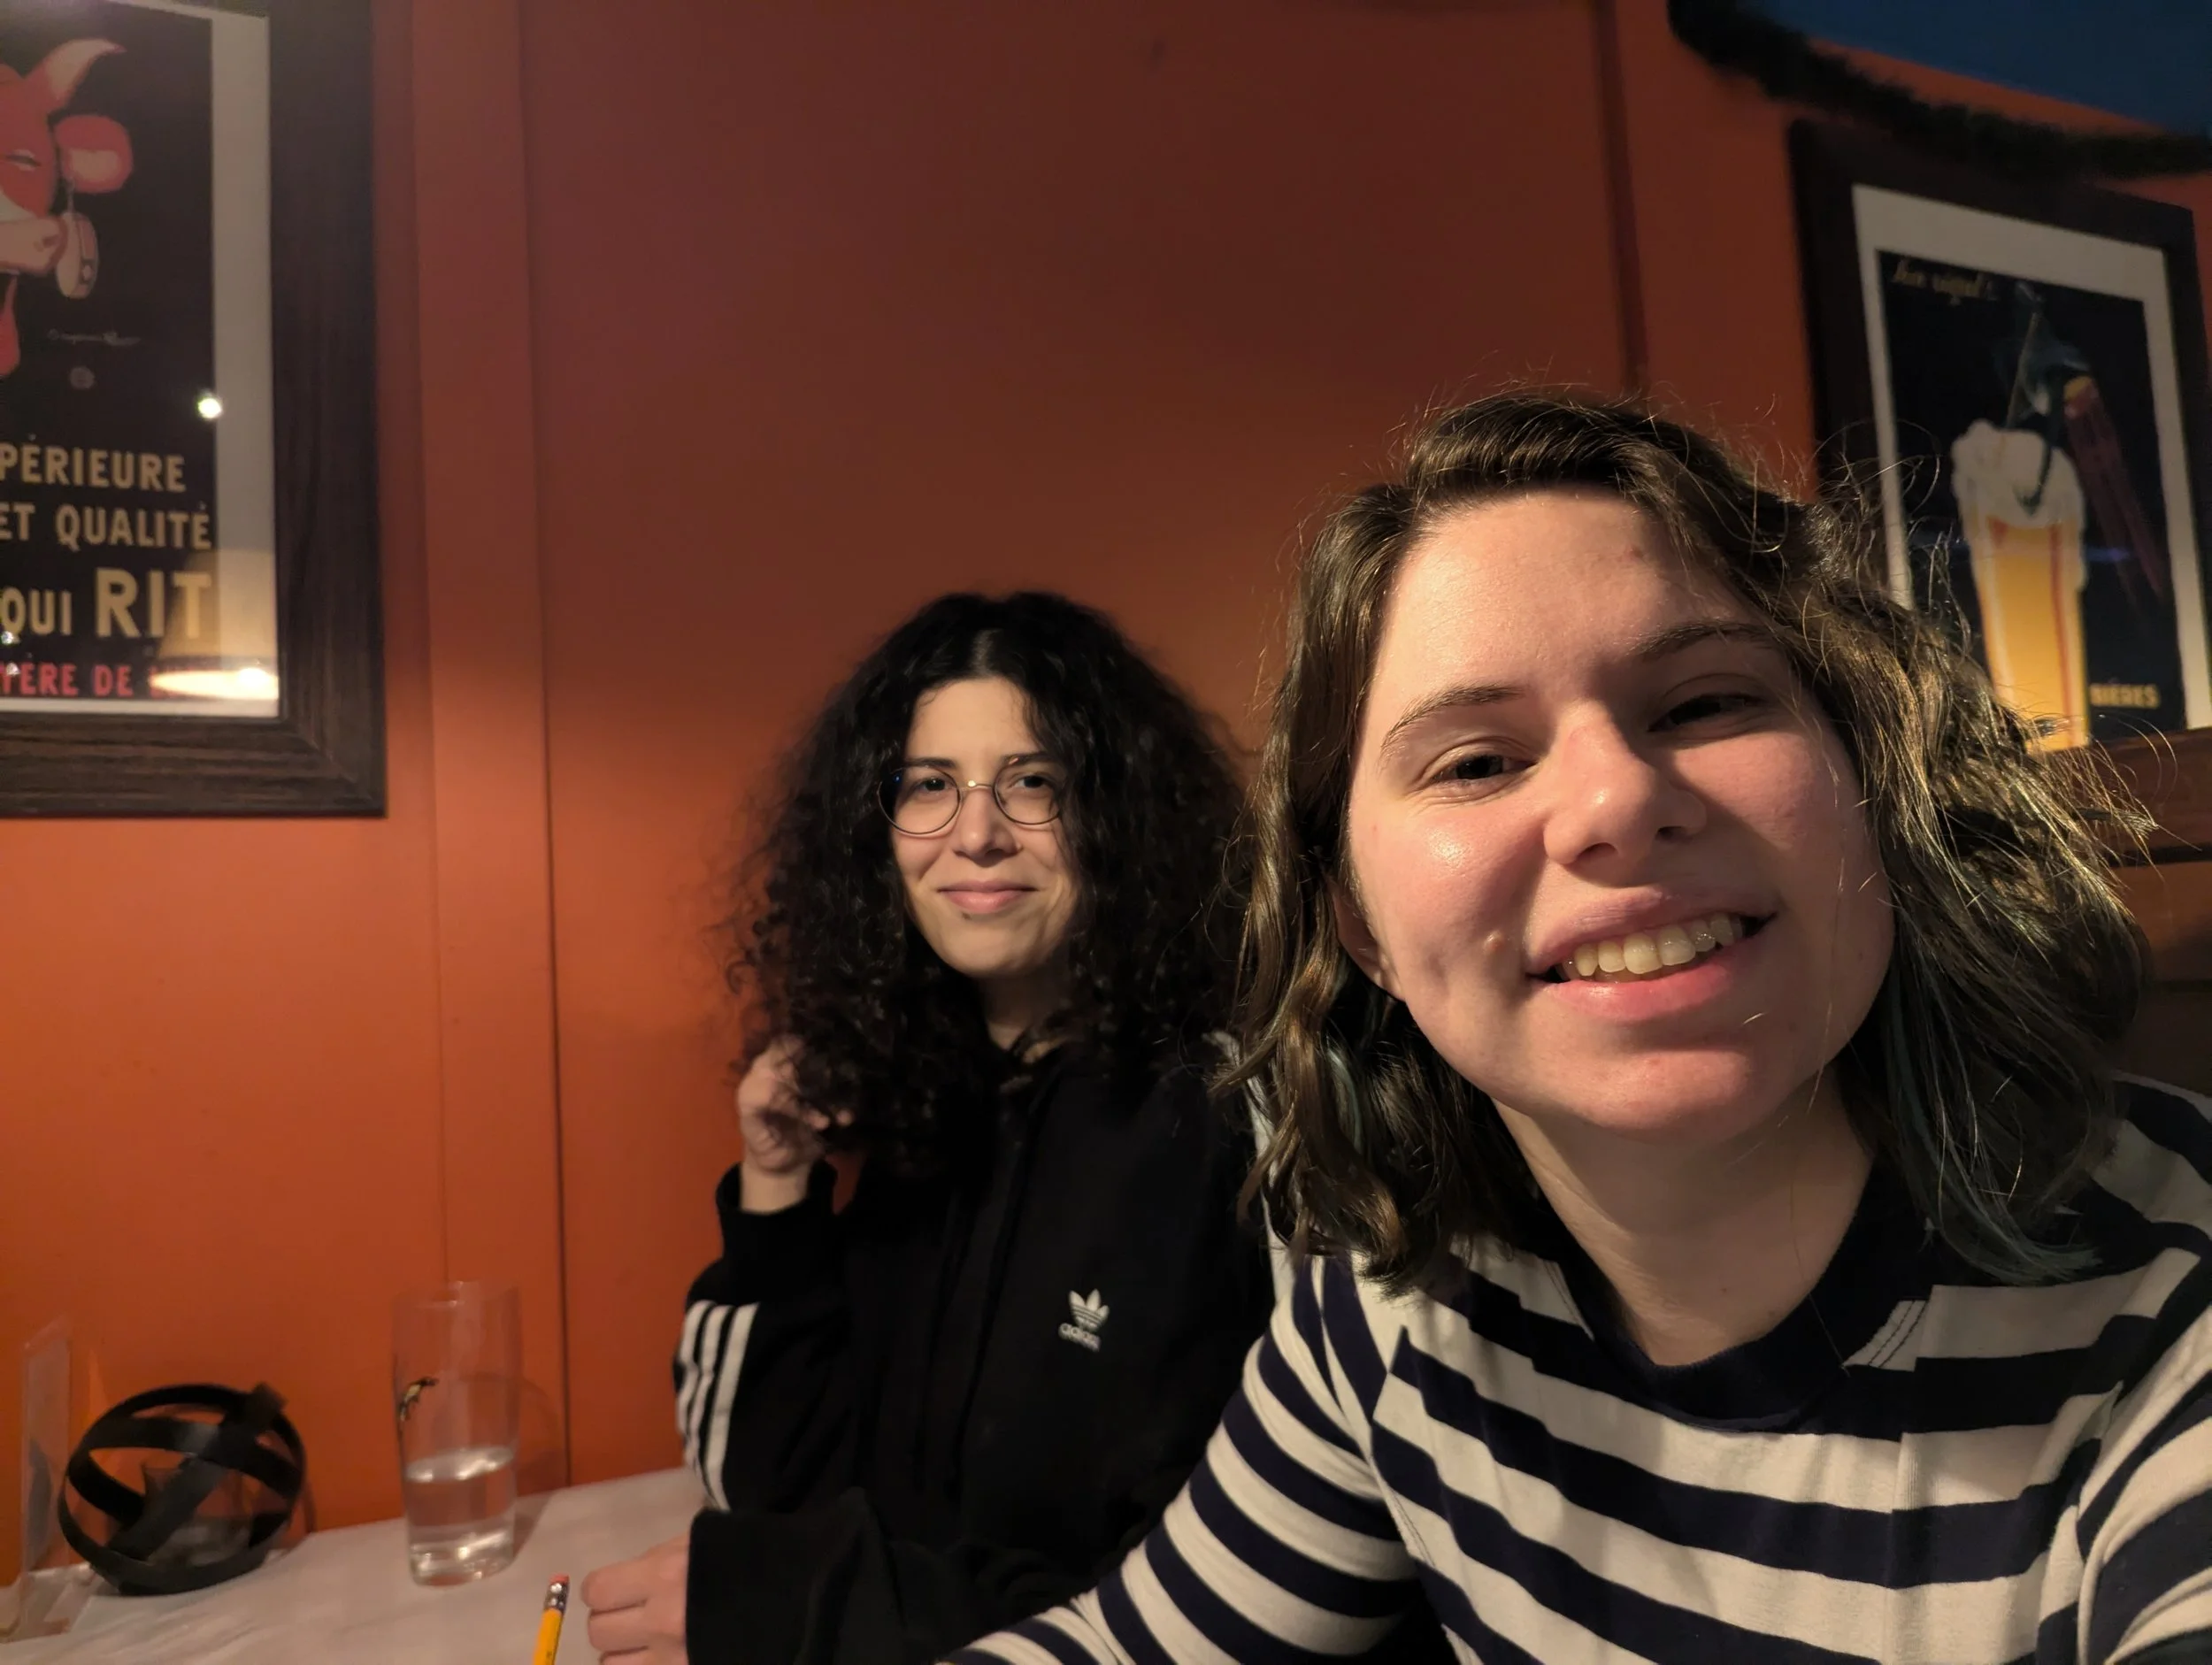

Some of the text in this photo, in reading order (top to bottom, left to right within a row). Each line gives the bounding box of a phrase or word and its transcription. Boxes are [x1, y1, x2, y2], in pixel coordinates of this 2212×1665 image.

[55, 500, 213, 553] QUALITÉ
[0, 566, 212, 644] QUI RIT
[93, 664, 134, 698] DE
